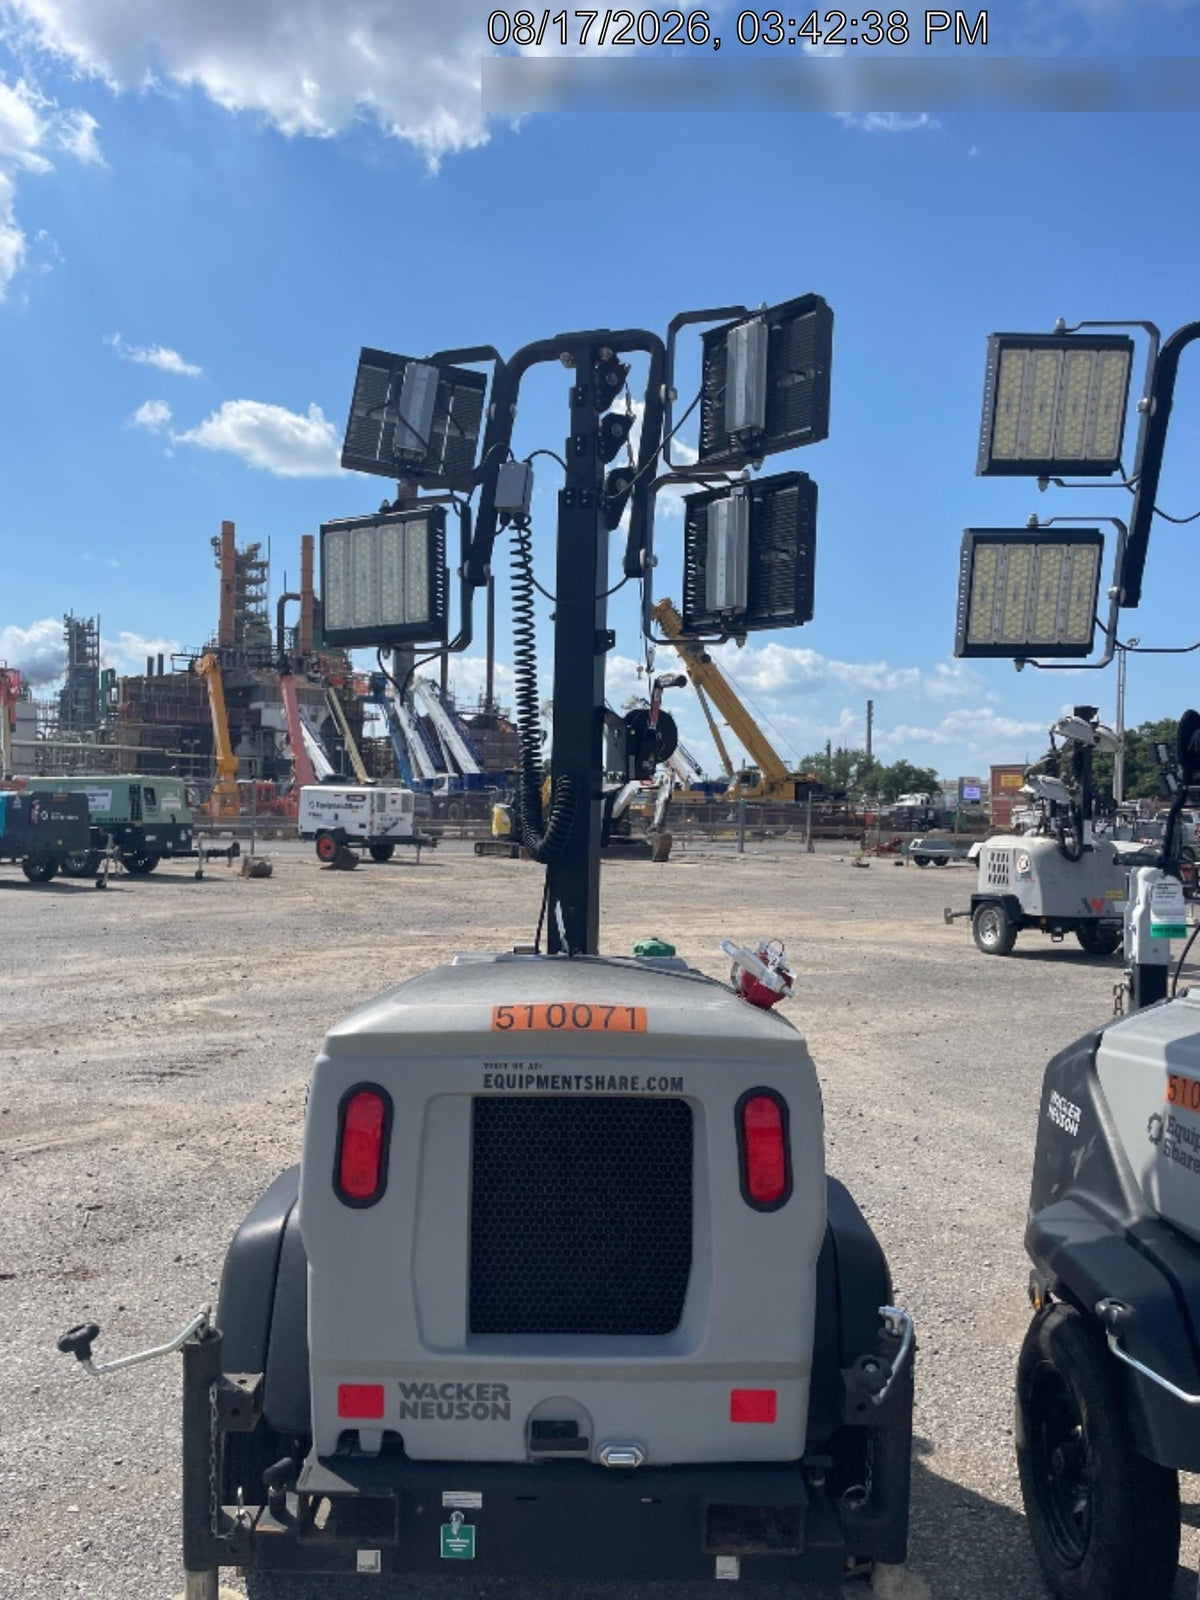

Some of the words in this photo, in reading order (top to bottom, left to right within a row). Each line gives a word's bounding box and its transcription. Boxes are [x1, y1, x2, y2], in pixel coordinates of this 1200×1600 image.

[495, 1003, 637, 1030] 510071
[483, 1073, 684, 1092] EQUIPMENTSHARE.COM
[398, 1381, 511, 1402] WACKER
[399, 1400, 511, 1421] NEUSON
